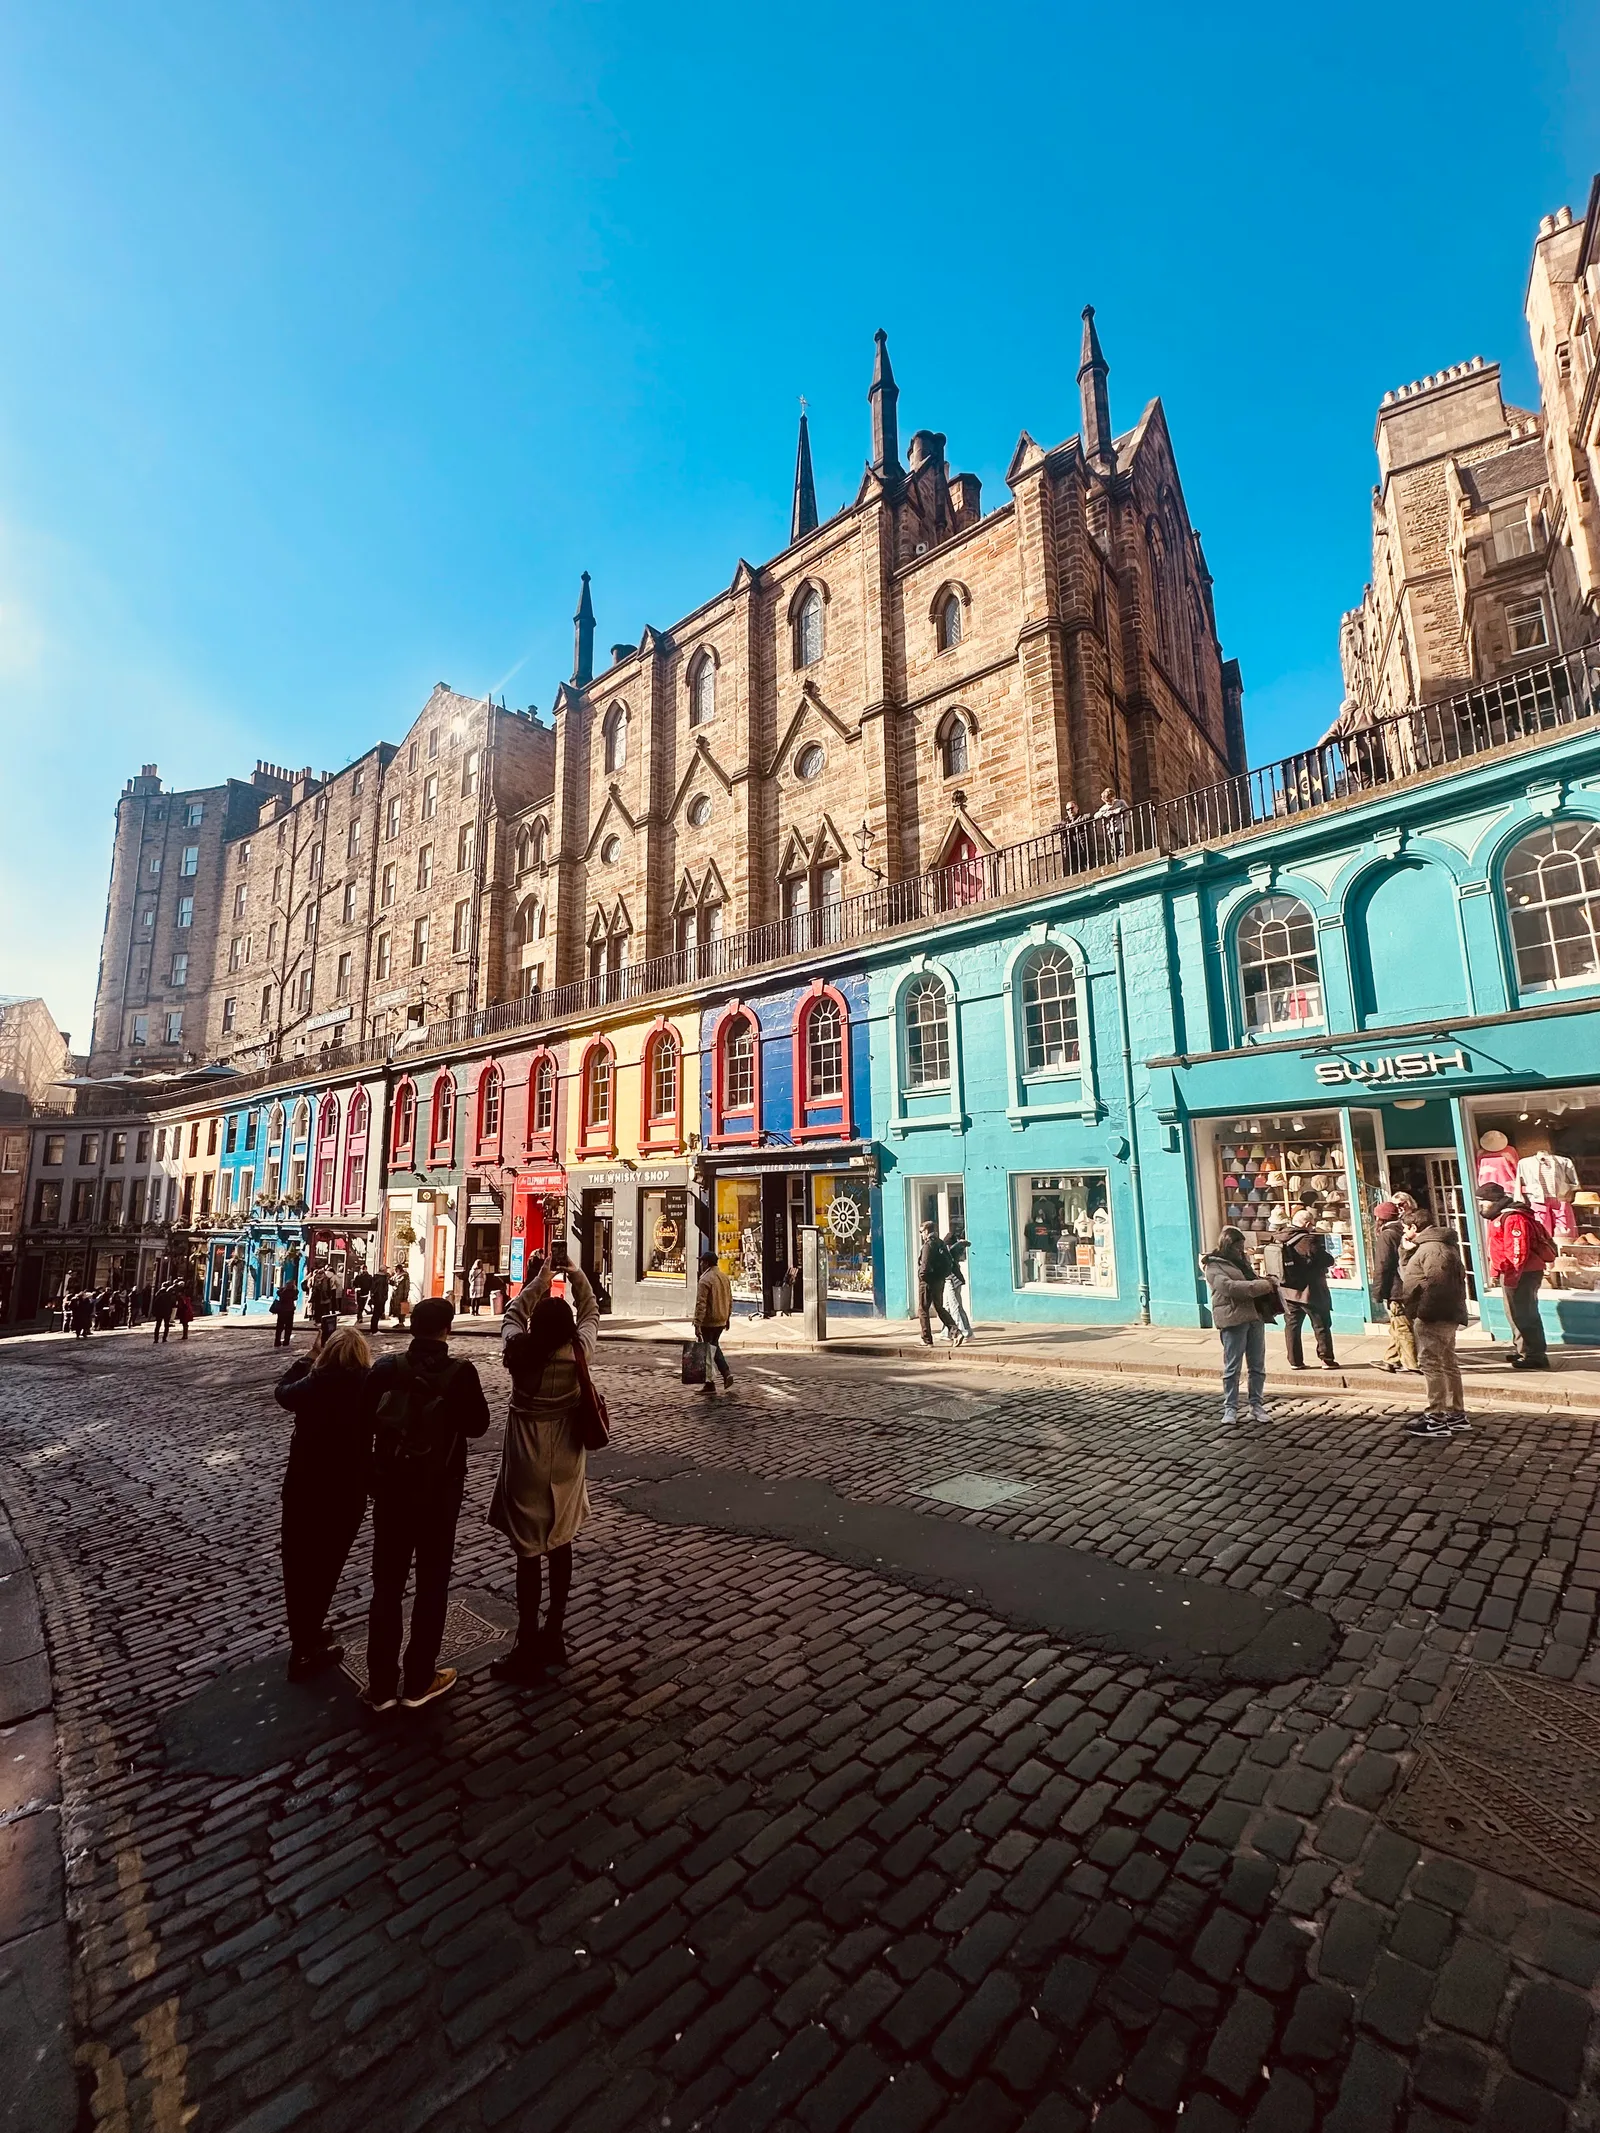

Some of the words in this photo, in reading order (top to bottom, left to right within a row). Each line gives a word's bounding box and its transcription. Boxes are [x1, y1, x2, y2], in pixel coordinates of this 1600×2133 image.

[1314, 1048, 1465, 1084] SWISH
[588, 1174, 605, 1183] THE
[607, 1171, 642, 1183] WHISKY
[644, 1170, 670, 1181] SHOP
